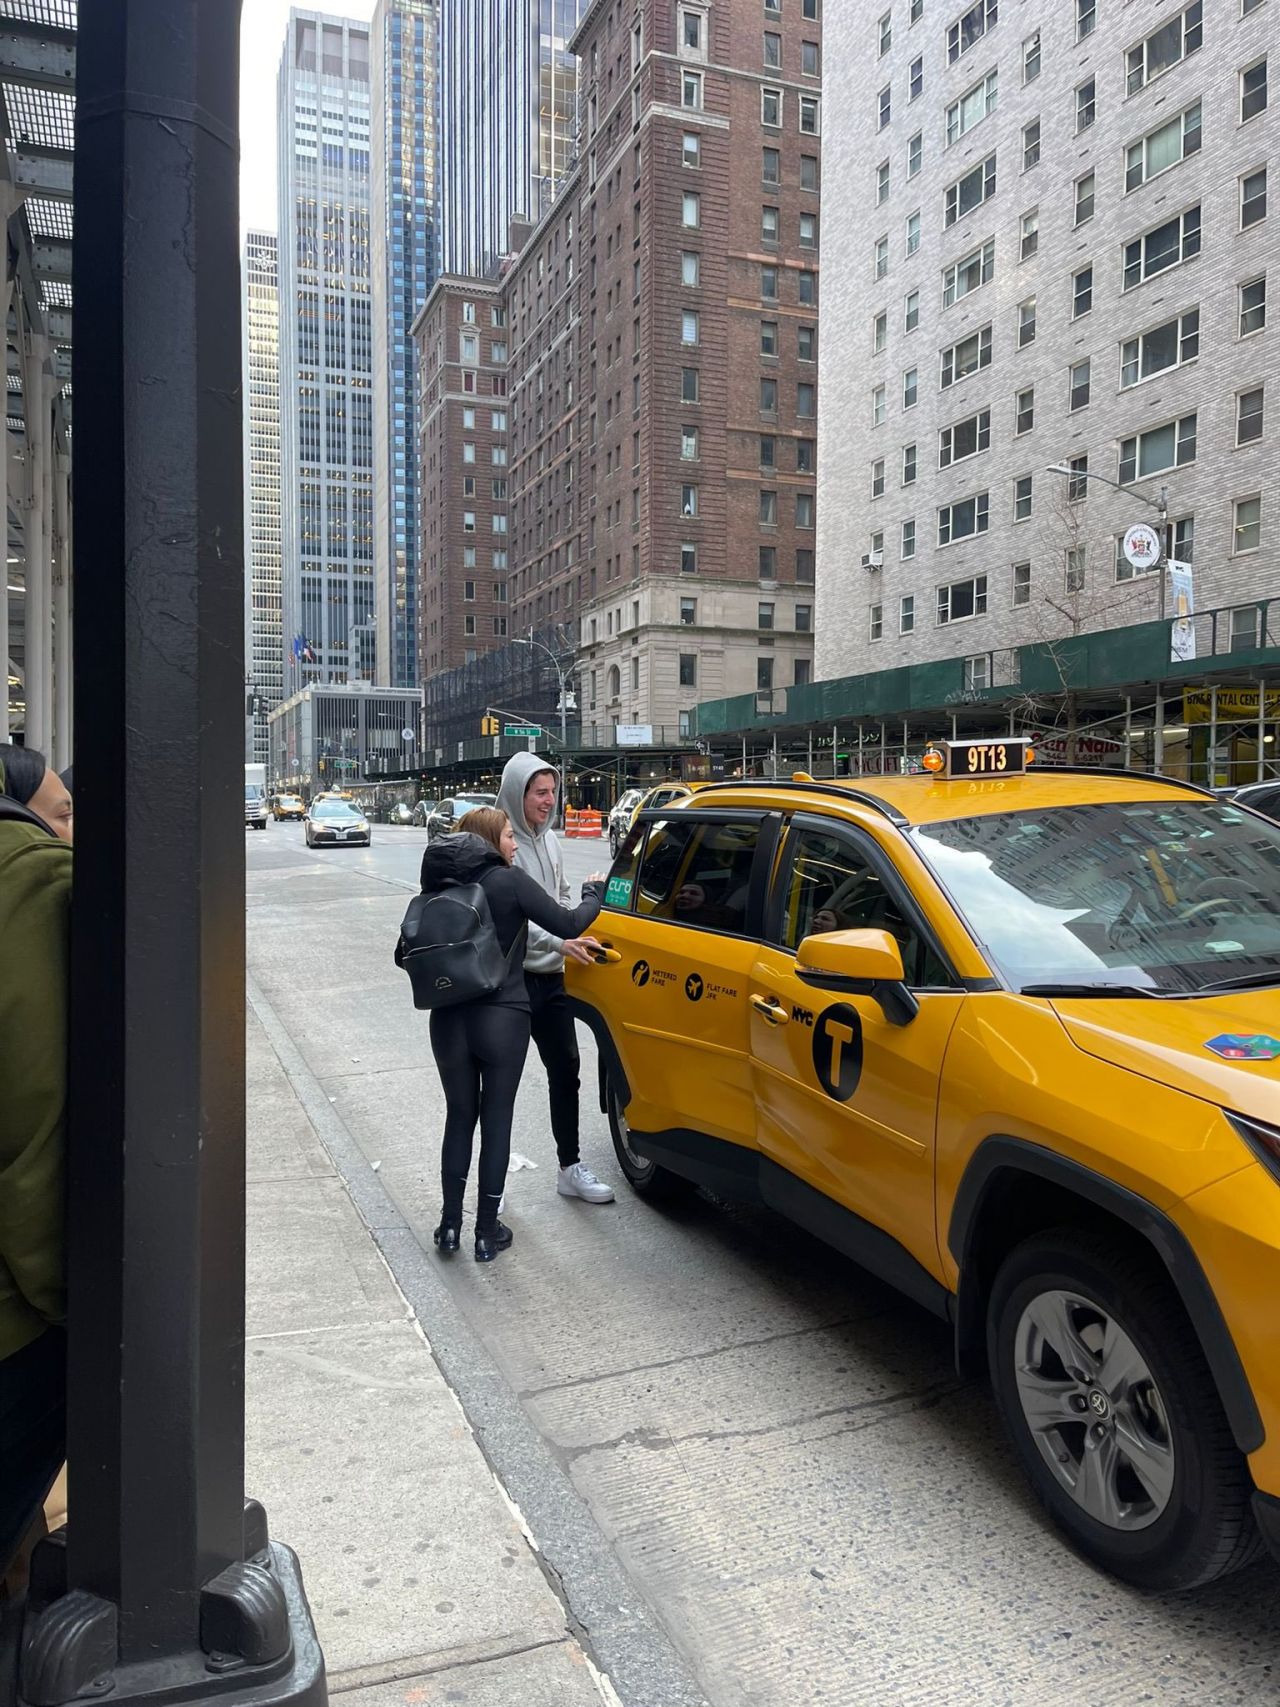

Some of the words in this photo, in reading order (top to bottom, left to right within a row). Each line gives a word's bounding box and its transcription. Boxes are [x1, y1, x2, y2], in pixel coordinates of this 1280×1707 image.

[1207, 693, 1238, 705] RNTAL
[968, 745, 1007, 772] 9T13
[608, 880, 632, 894] curb
[652, 969, 678, 981] METERED
[651, 978, 665, 987] FARE
[705, 992, 717, 1000] JFK
[706, 983, 721, 992] FLAT
[722, 987, 738, 998] FARE
[792, 1006, 814, 1027] NYC
[824, 1018, 854, 1088] T
